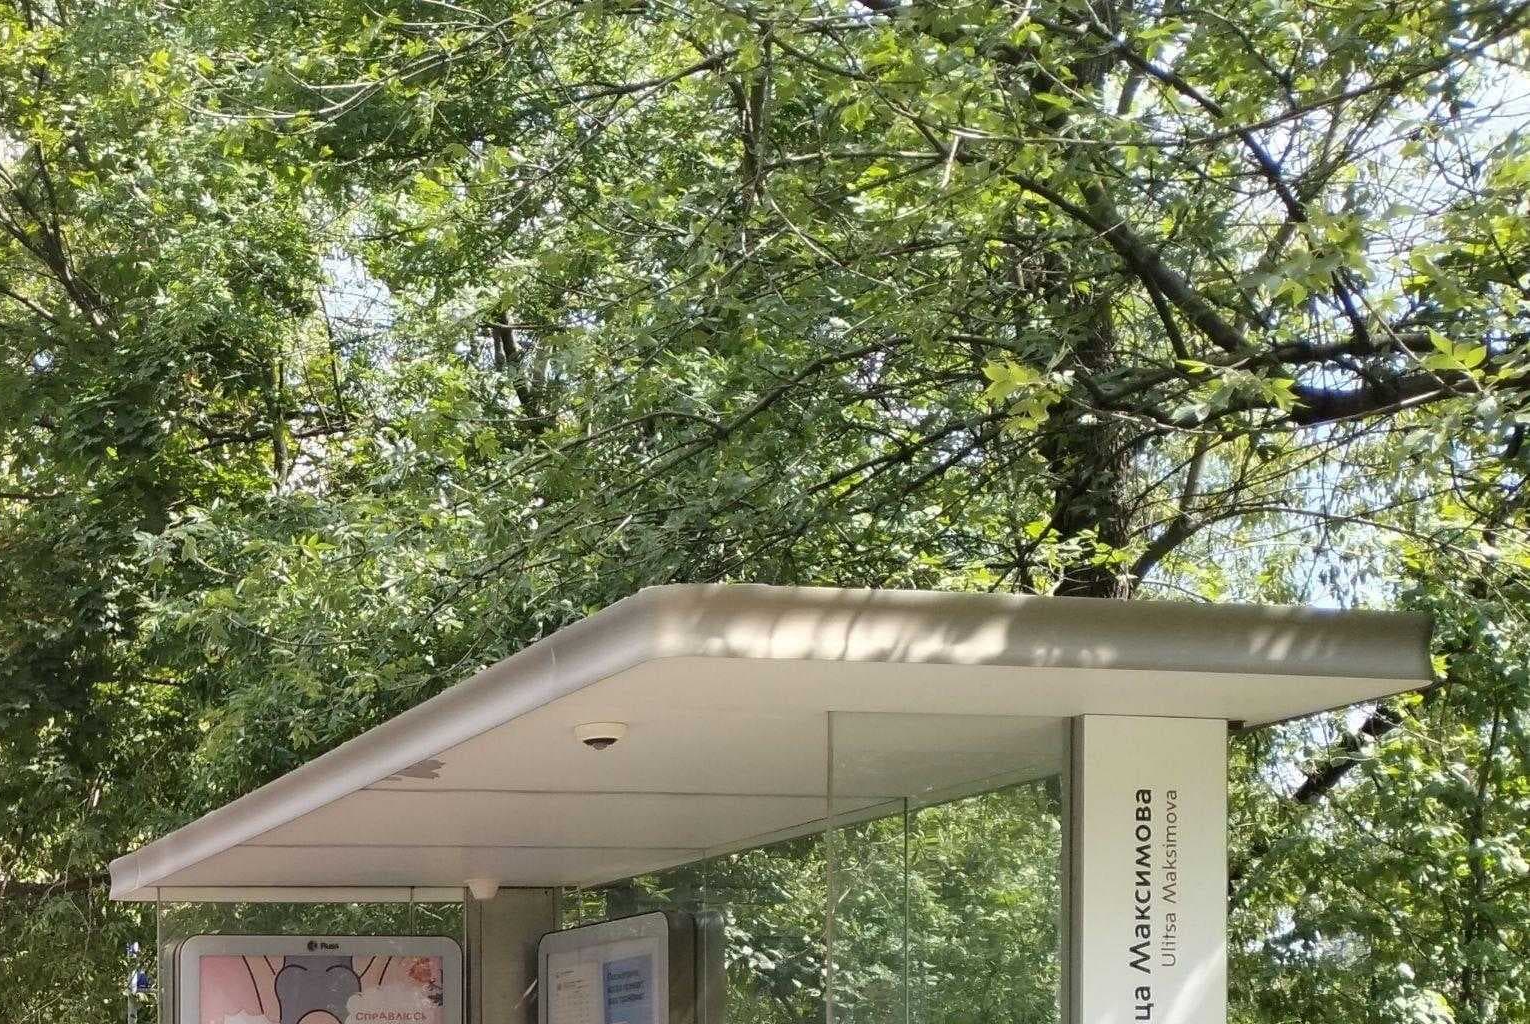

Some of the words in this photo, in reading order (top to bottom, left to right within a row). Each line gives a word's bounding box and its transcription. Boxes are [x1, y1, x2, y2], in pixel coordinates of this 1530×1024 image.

[1129, 788, 1153, 974] Максимова
[1161, 789, 1178, 904] Maksimova
[1161, 911, 1177, 968] Ulitsa
